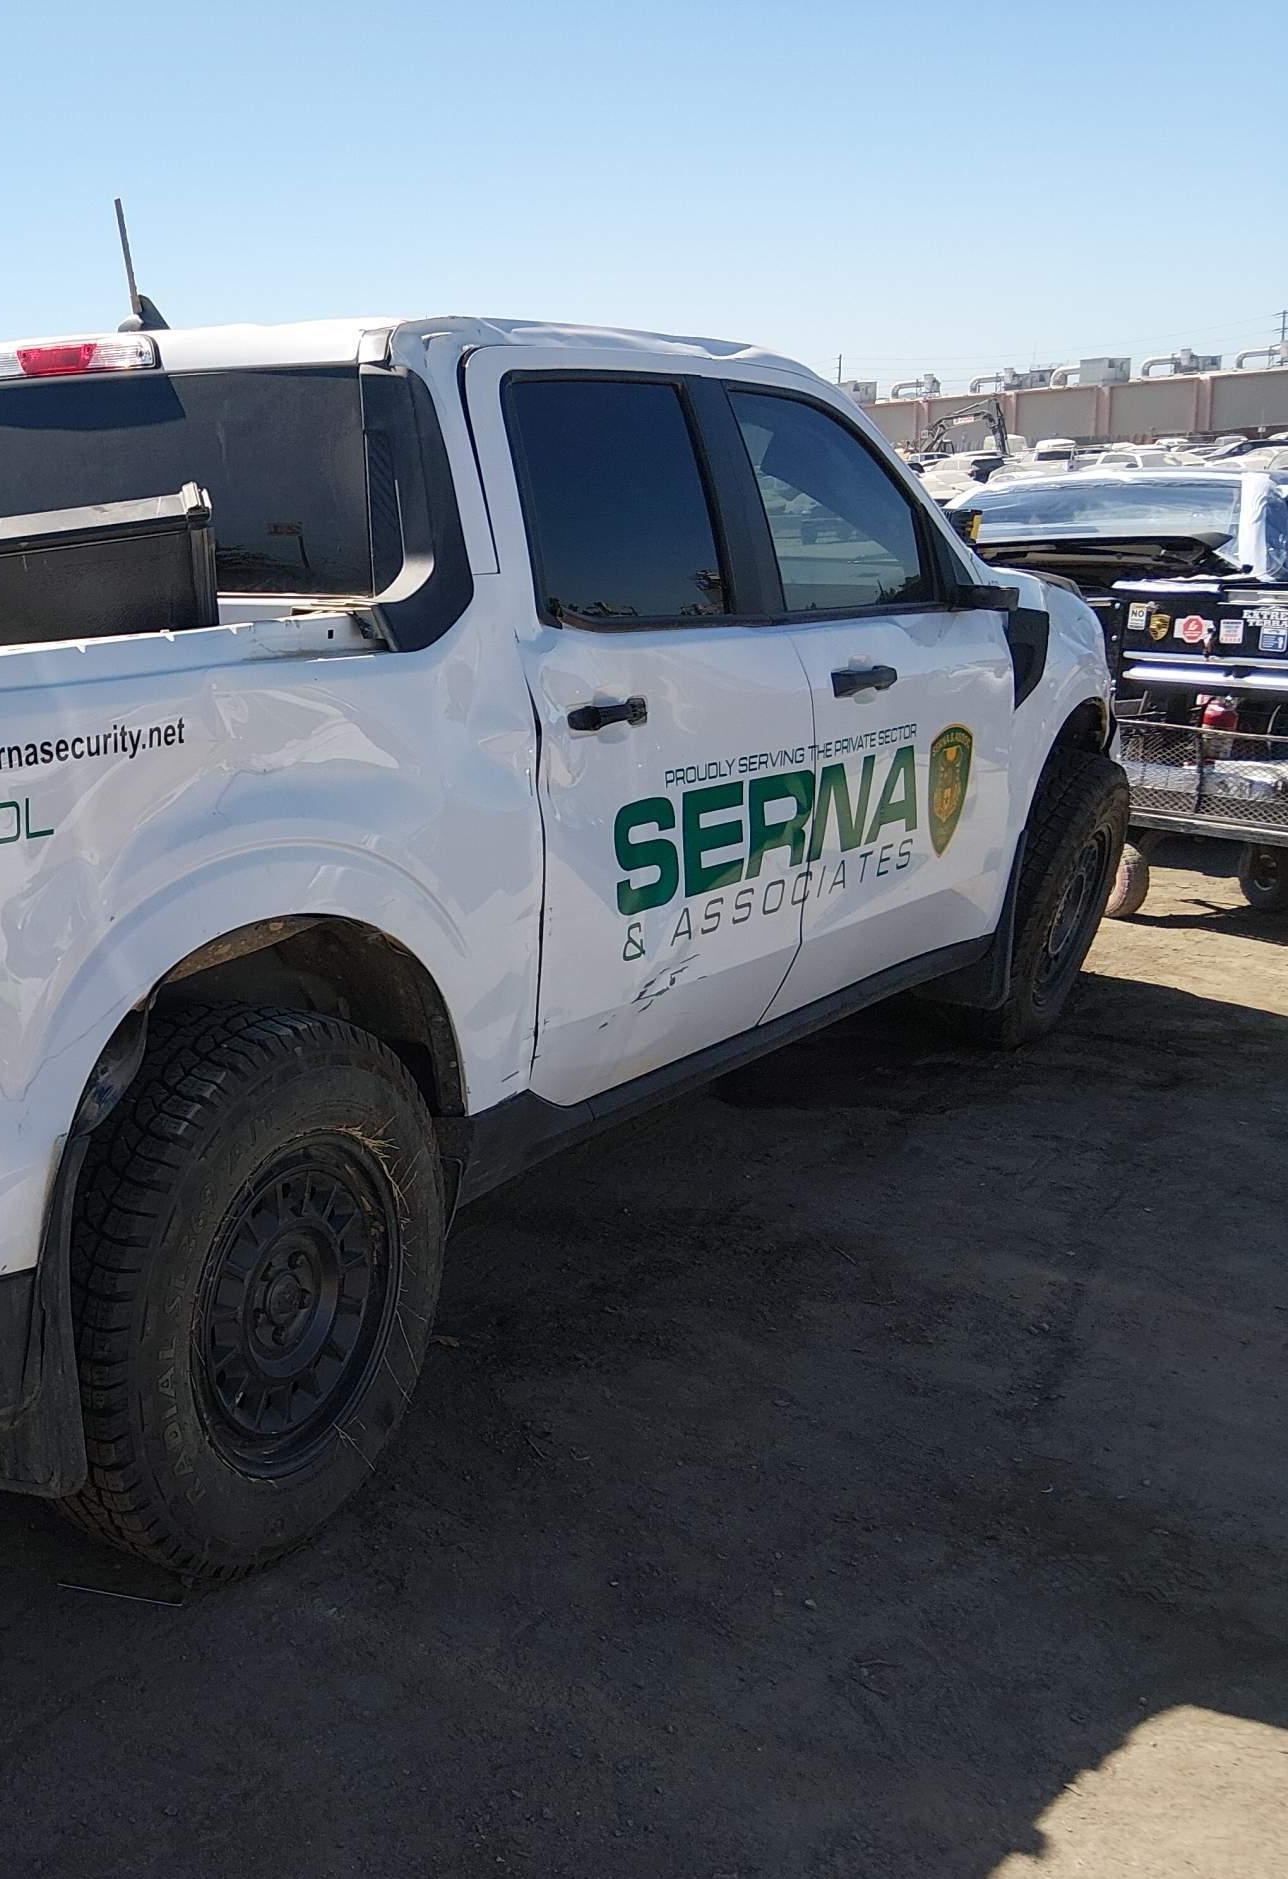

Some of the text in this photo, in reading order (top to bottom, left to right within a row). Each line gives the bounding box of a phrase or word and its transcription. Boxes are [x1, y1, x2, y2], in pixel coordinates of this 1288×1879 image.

[1131, 610, 1145, 618] NO
[665, 758, 735, 789] PROUDLY
[738, 747, 806, 774] SERVING
[809, 741, 833, 764] THE
[835, 731, 877, 758] PRIVATE
[879, 723, 918, 748] SECTOR
[614, 744, 918, 916] SERNA
[622, 838, 914, 962] & ASSOCIATES
[154, 1338, 208, 1506] RADIAL
